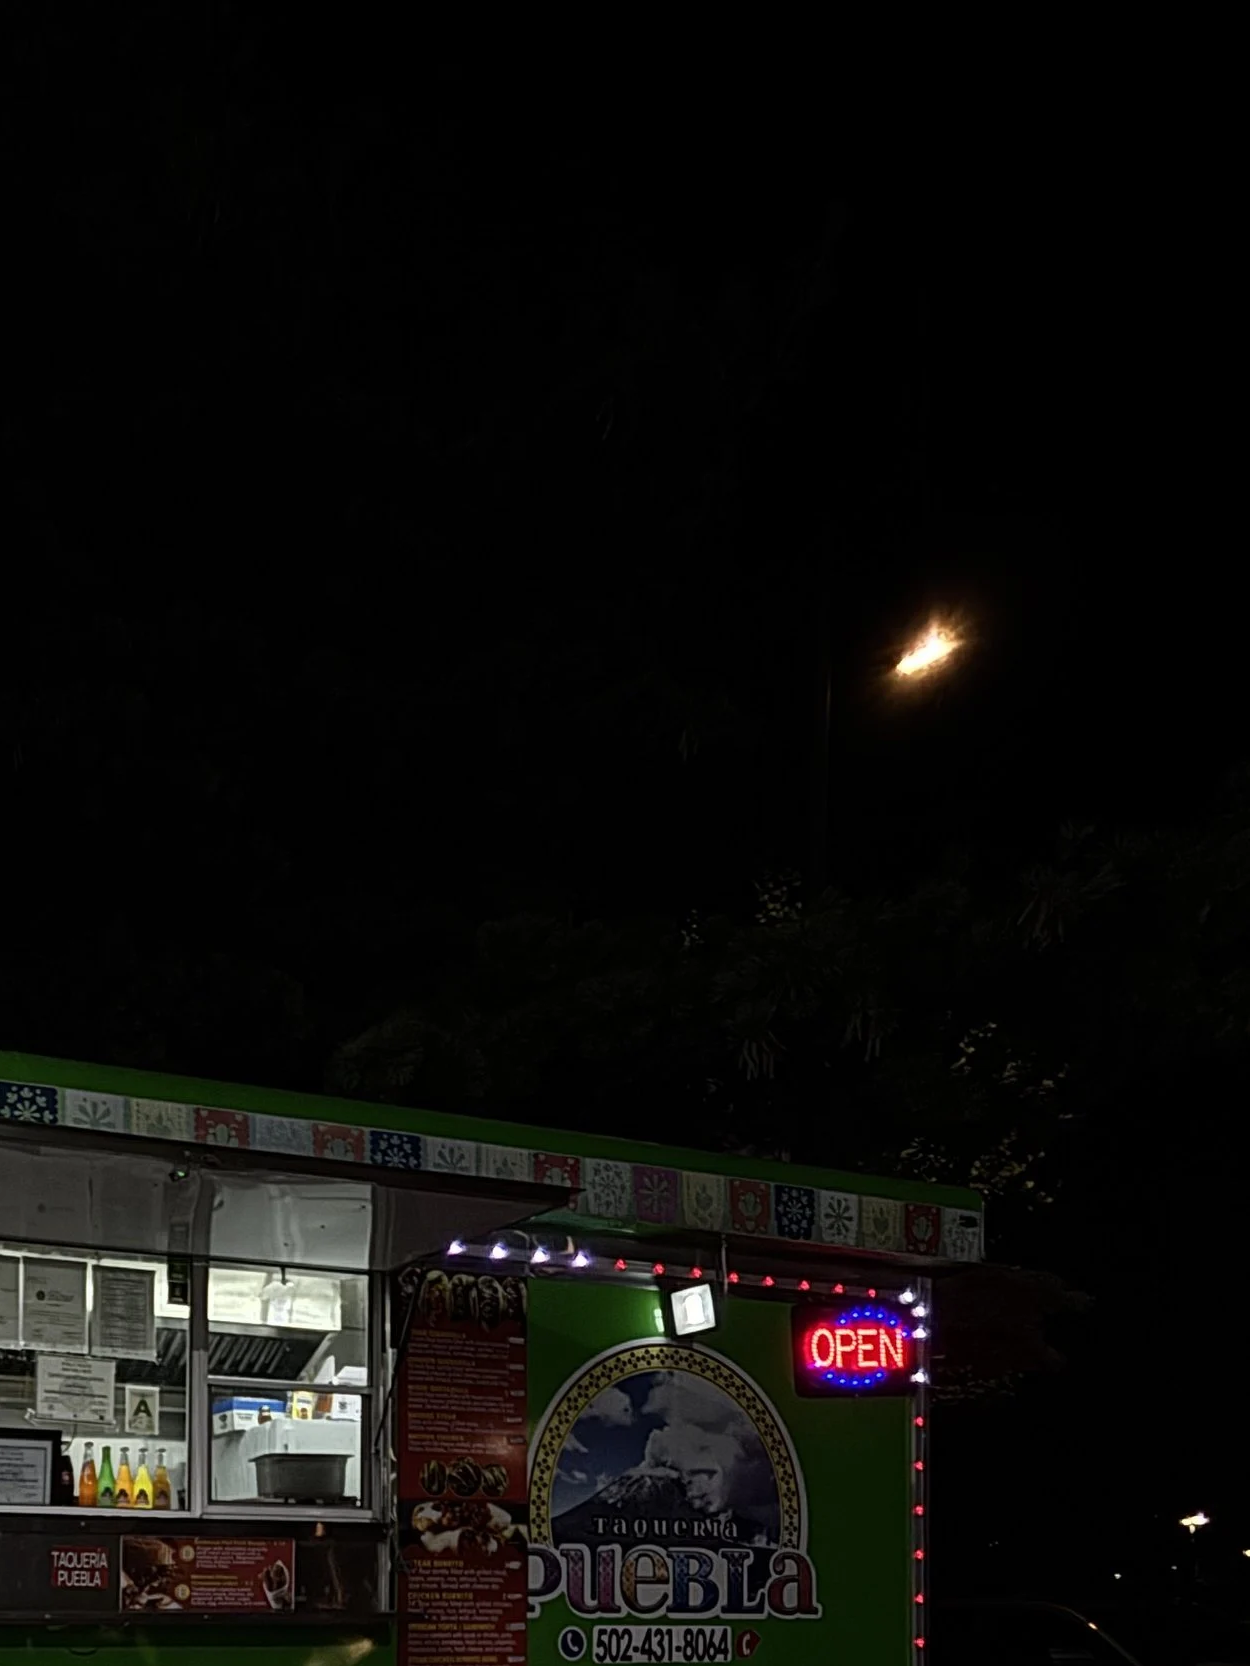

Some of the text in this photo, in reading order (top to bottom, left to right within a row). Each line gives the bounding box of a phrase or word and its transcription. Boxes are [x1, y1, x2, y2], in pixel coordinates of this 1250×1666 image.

[810, 1327, 904, 1368] OPEN
[133, 1398, 152, 1417] A
[57, 1570, 101, 1587] PUEBLA
[595, 1628, 729, 1662] 502-431-8064
